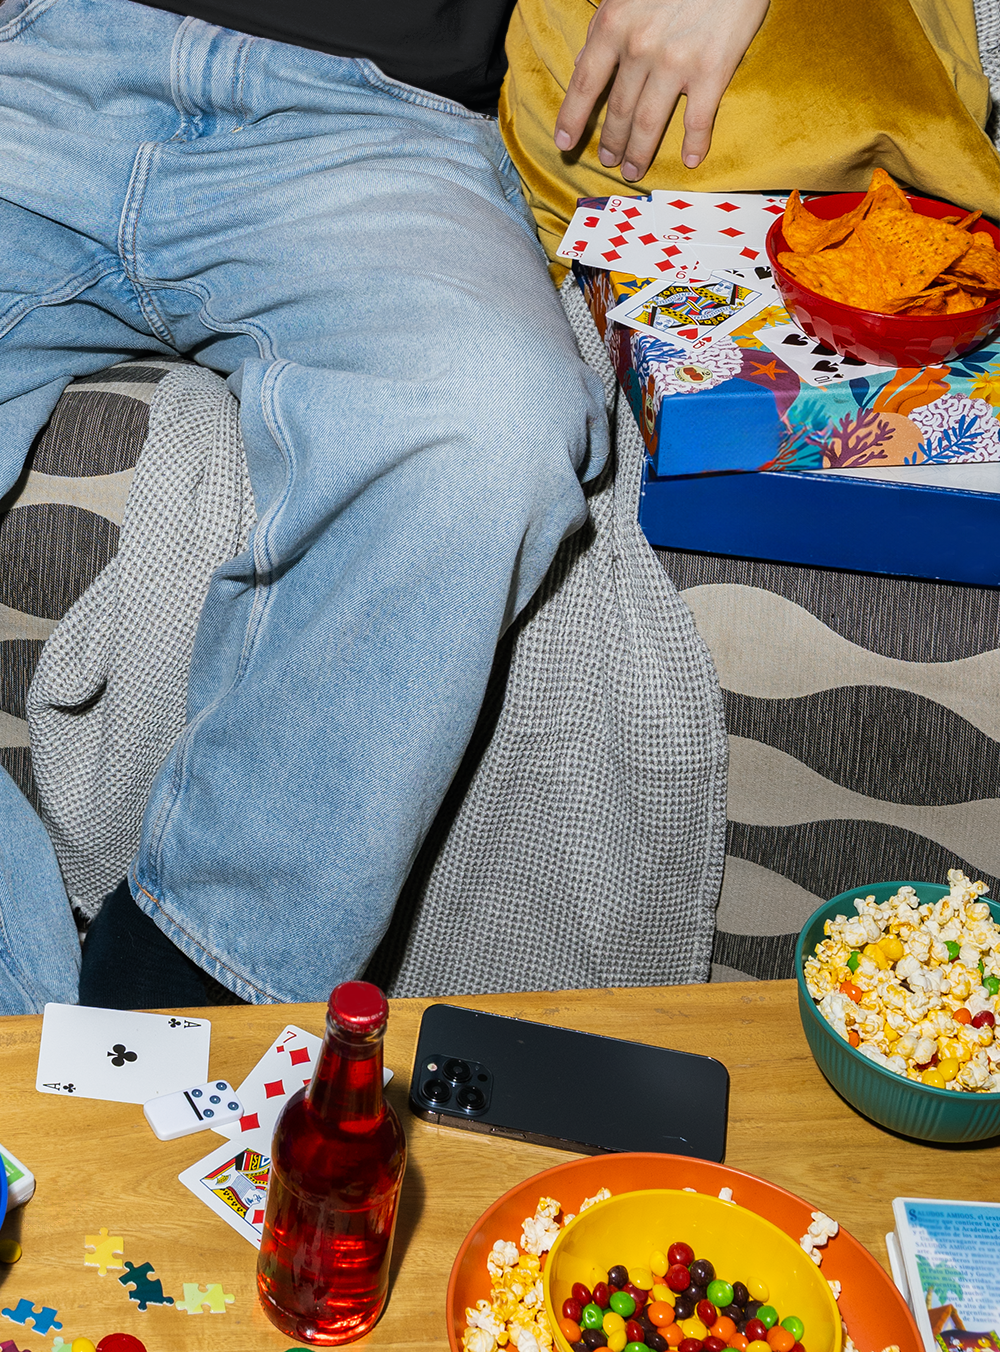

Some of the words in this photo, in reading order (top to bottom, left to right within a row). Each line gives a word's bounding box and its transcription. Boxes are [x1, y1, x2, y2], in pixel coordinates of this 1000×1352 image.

[183, 1019, 202, 1029] A
[282, 1030, 298, 1044] 7
[42, 1082, 62, 1092] A
